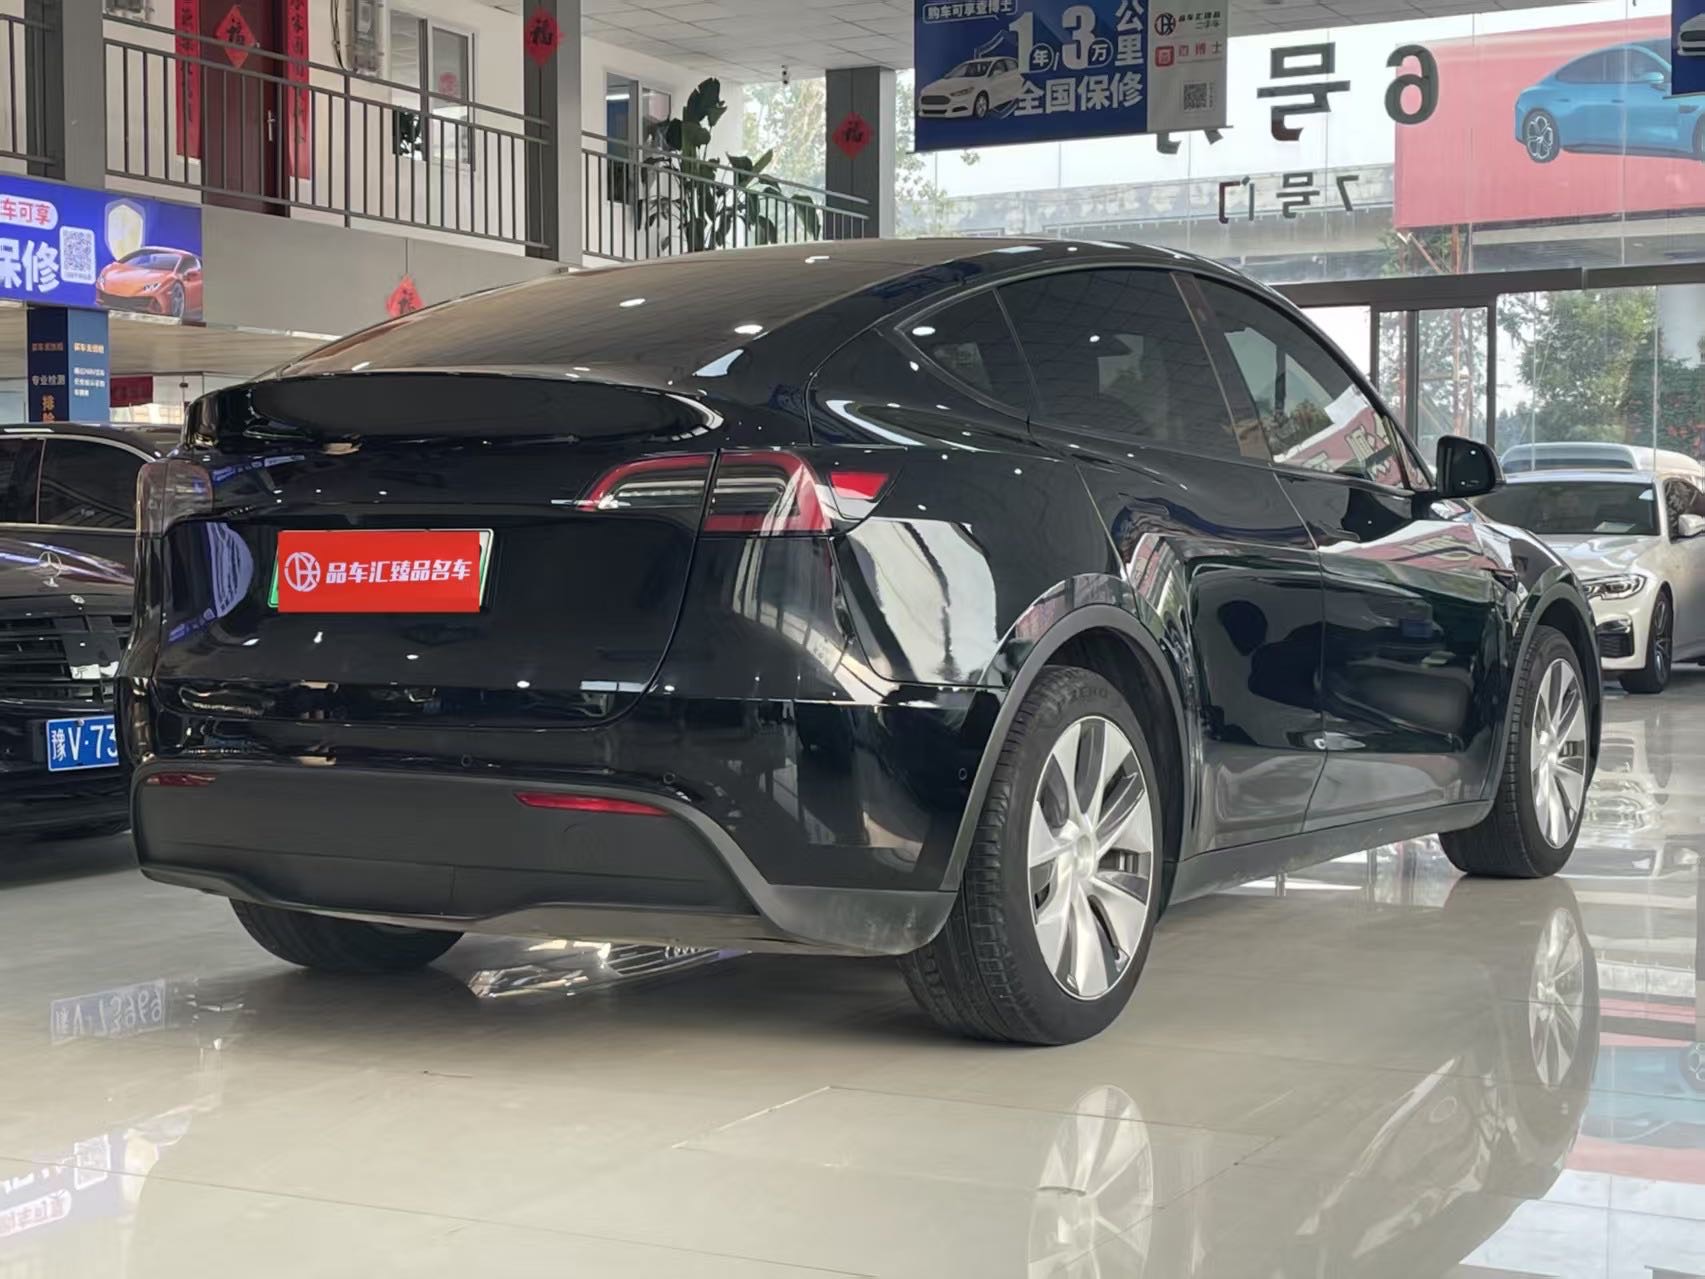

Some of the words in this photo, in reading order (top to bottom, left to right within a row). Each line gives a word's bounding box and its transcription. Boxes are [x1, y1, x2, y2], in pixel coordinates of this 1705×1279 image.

[1013, 71, 1144, 117] 全国保修
[326, 559, 472, 584] 品车汇臻品名车
